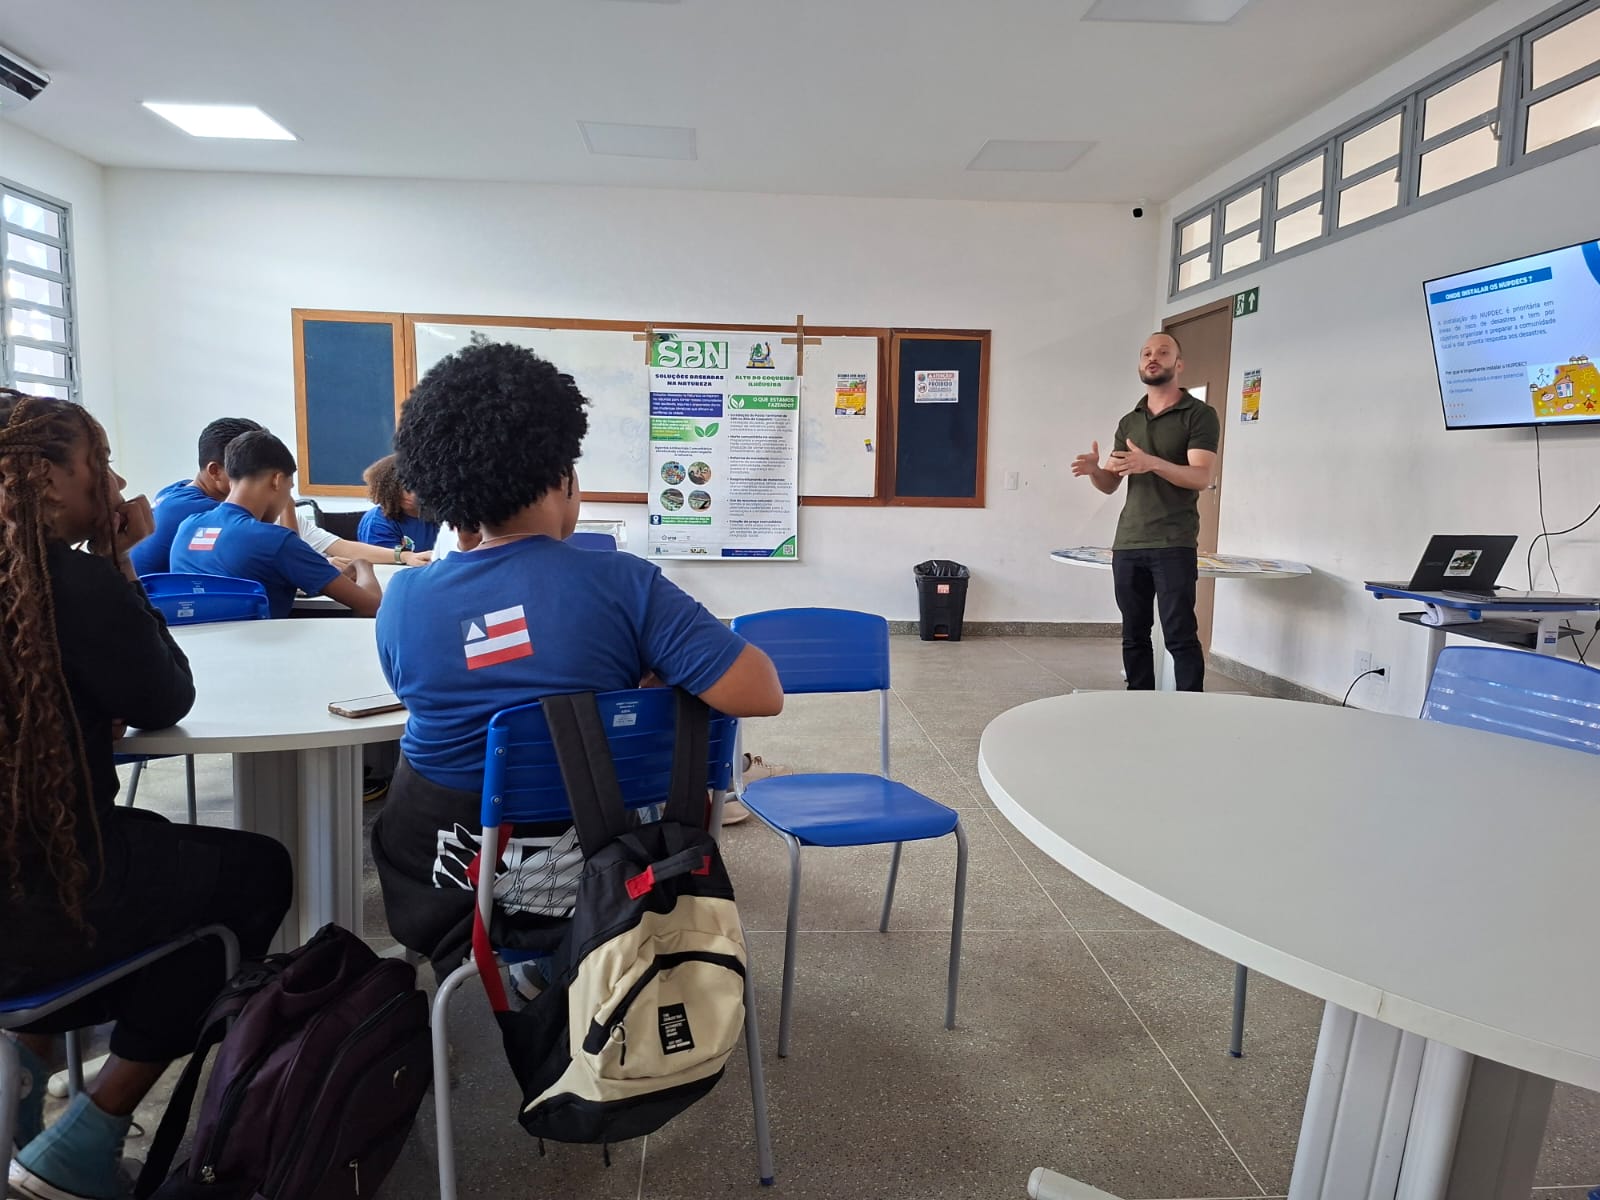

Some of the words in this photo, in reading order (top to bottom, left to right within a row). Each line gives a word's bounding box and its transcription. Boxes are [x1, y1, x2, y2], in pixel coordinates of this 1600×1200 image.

[1445, 292, 1460, 300] ONDE
[1461, 286, 1488, 297] INSTALAR
[1489, 283, 1498, 291] OS
[1499, 277, 1527, 289] NUPDECS
[1480, 309, 1503, 319] NUPDEC
[1512, 302, 1540, 313] prioritária
[1519, 318, 1556, 329] comunidade
[658, 341, 728, 369] SBN
